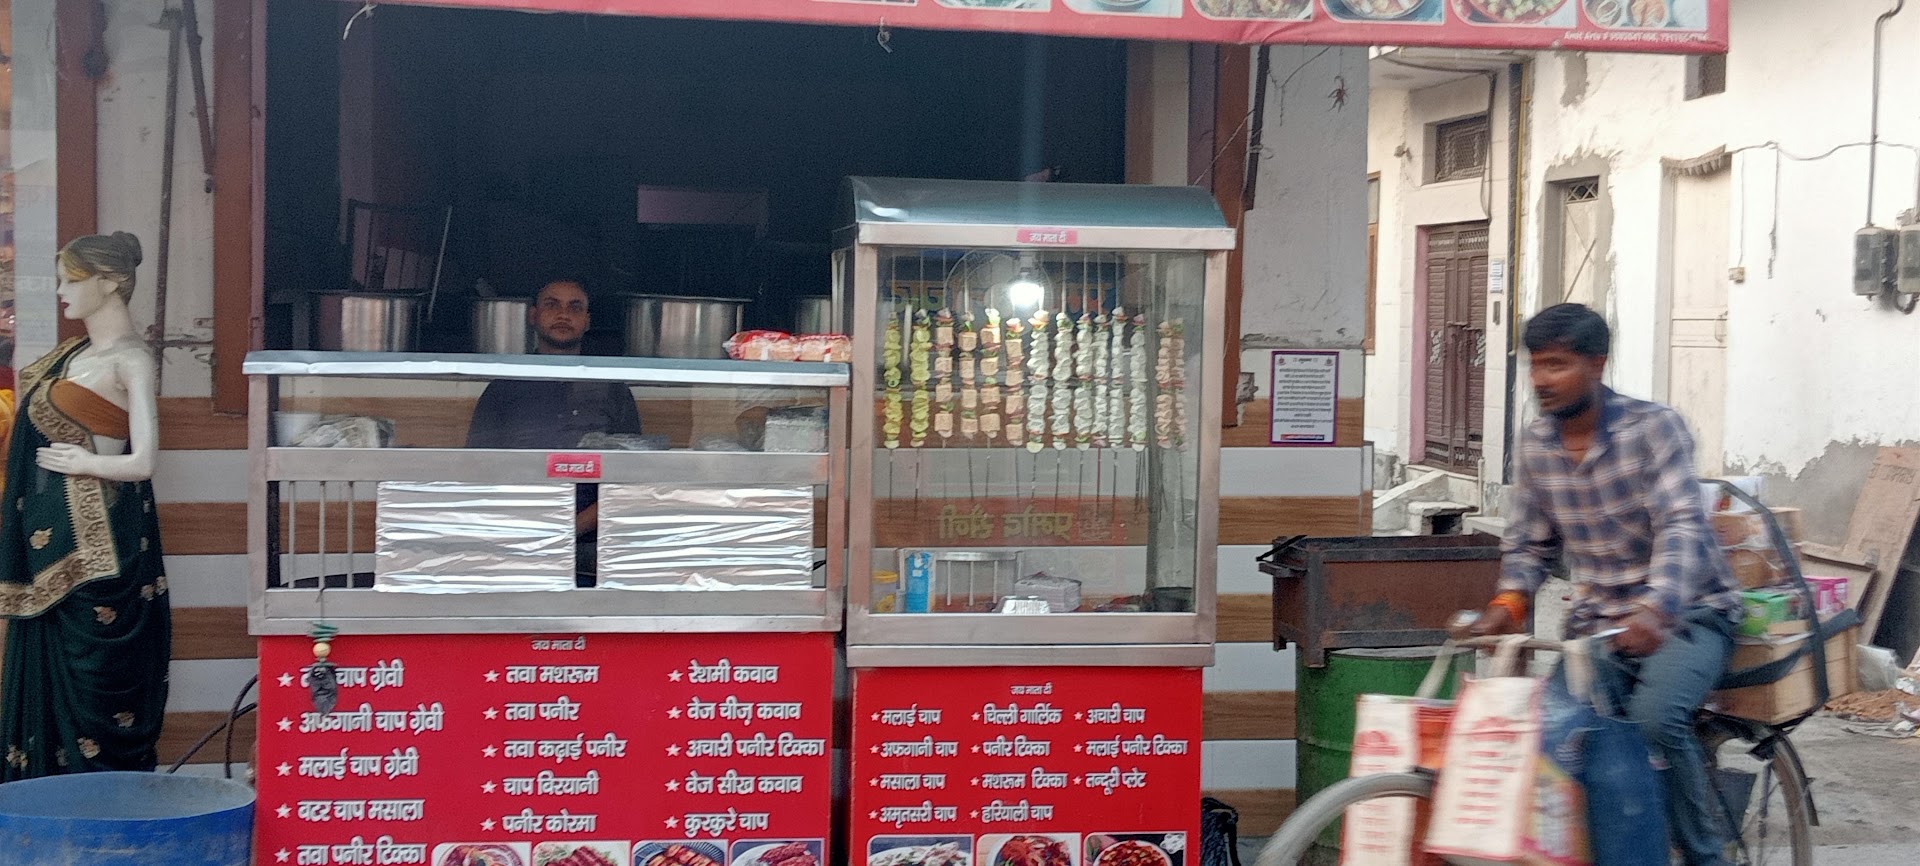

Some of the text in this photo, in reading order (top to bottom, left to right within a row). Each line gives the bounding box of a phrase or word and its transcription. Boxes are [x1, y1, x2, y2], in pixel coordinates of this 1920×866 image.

[335, 668, 367, 687] चाप
[370, 659, 404, 691] ग्रेवी
[506, 666, 599, 683] तवा मशरूम
[688, 659, 731, 683] रेशमी
[375, 712, 407, 731] चाप
[410, 703, 444, 734] ग्रेवी
[506, 696, 580, 720] तवा पनीर
[687, 697, 716, 719] वेज
[882, 704, 941, 726] मलाई चाप
[984, 703, 1018, 724] चिल्ली
[1087, 703, 1145, 723] अचारी चाप
[504, 741, 535, 757] तवा
[586, 733, 627, 757] पनीर
[686, 732, 825, 757] अचारी पनीर टिक्का
[881, 736, 958, 757] अफगानी चाप
[983, 735, 1050, 756] पनीर टिक्का
[1086, 735, 1187, 757] मलाई पनीर टिक्का
[299, 747, 419, 779] मलाई चाप ग्रेवी
[504, 778, 534, 795] चाप
[686, 771, 714, 793] वेज
[717, 770, 755, 794] सीख
[880, 775, 945, 790] मसाला चाप
[983, 768, 1067, 788] मशरूम टिक्का
[1122, 768, 1145, 787] प्लेट
[334, 801, 366, 820] चाप
[368, 800, 424, 821] मसाला
[503, 808, 596, 833] पनीर कोरमा
[880, 801, 957, 828] अमृतसरी चाप
[982, 800, 1053, 822] हरियाली चाप
[684, 808, 768, 841] कुरकुरे चाप
[297, 836, 427, 865] तवा पनीर टिक्का
